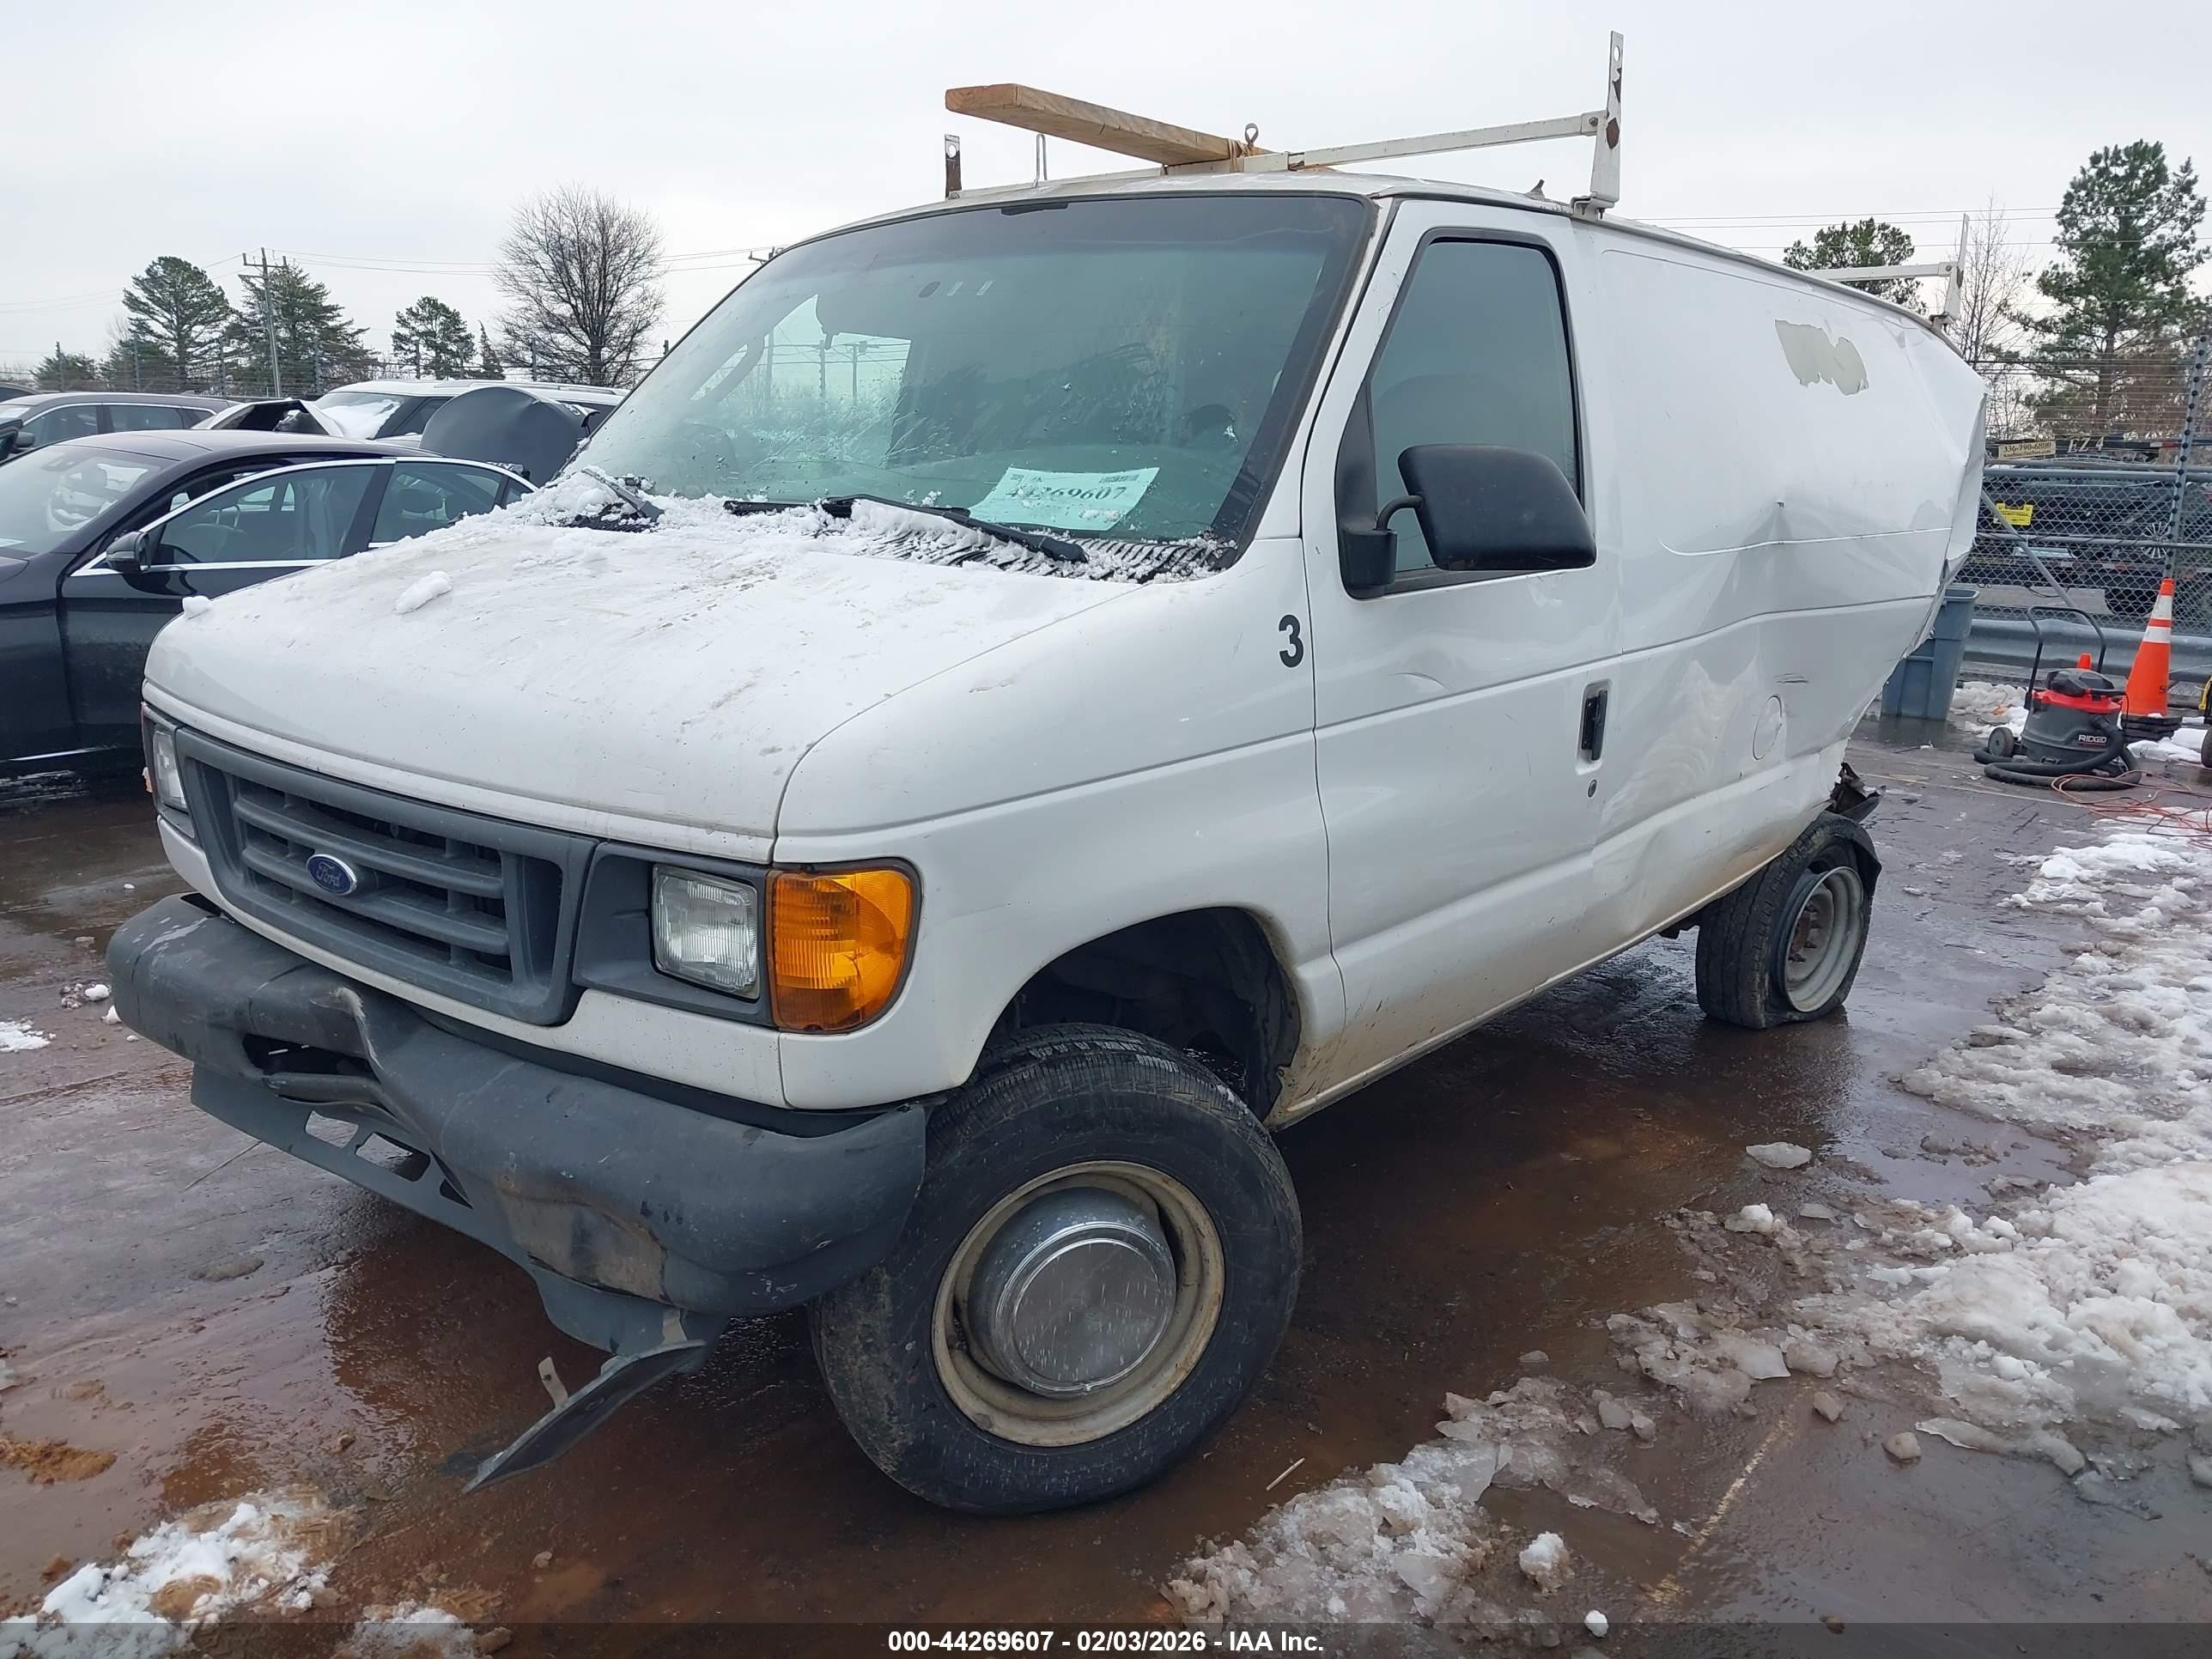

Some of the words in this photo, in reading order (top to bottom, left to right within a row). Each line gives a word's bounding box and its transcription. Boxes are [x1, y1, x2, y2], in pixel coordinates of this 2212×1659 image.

[2067, 437, 2090, 453] EZ
[2095, 436, 2105, 451] 4
[1278, 614, 1304, 668] 3
[316, 861, 341, 887] Ford
